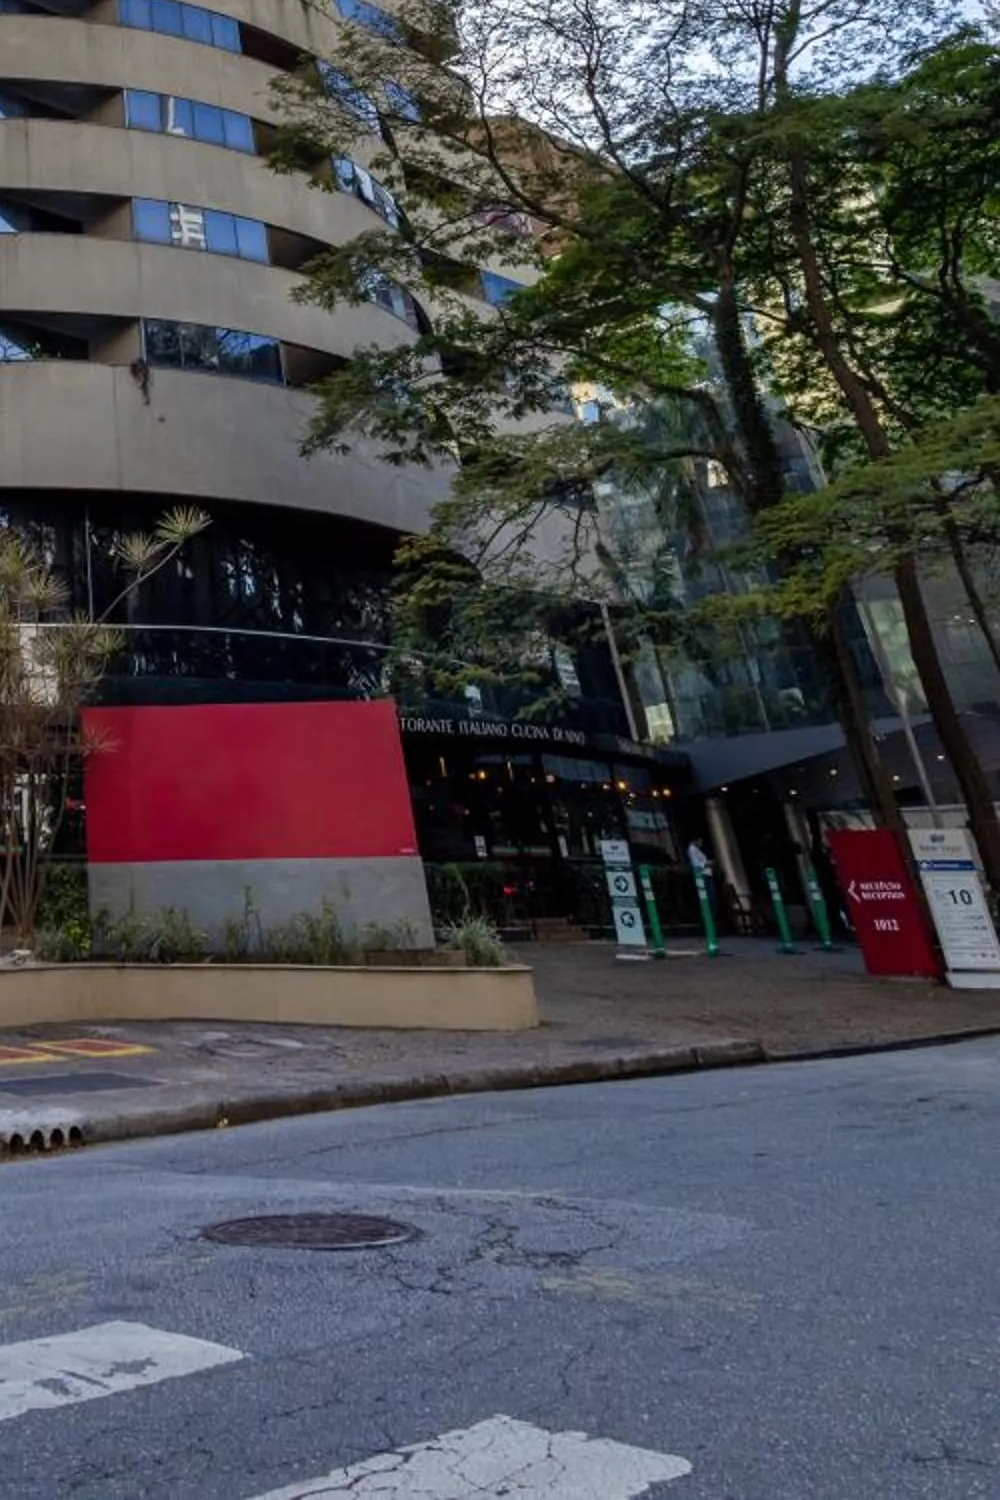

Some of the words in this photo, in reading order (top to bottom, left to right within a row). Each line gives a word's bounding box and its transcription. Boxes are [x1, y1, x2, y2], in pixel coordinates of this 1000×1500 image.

[400, 717, 454, 734] TORANTE
[459, 719, 507, 737] ITALIANO
[511, 723, 549, 739] CUCINA
[950, 889, 972, 905] 10
[873, 919, 900, 931] 1012
